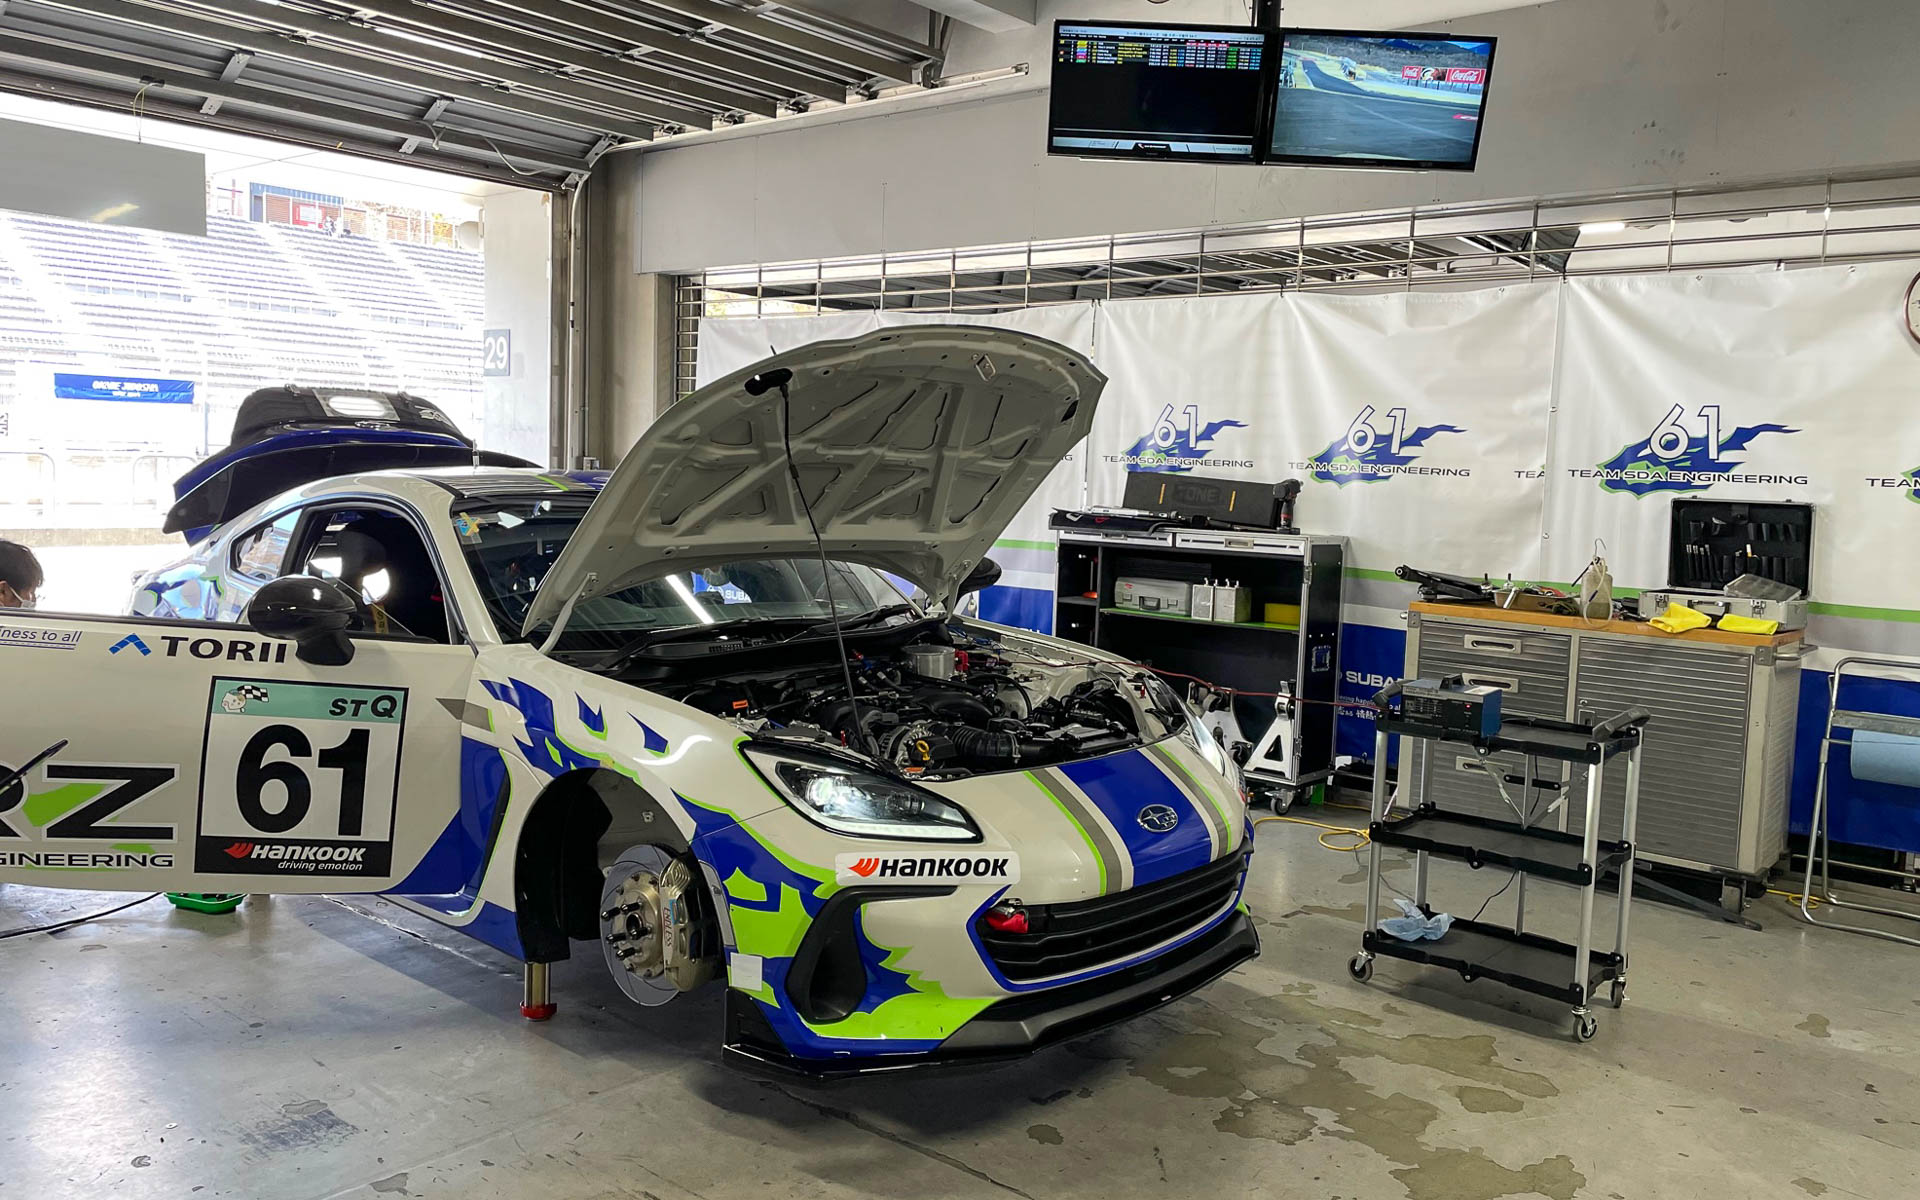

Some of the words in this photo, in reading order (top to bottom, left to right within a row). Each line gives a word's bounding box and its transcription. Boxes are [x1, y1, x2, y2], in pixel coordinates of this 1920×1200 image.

[484, 336, 507, 370] 29
[1154, 403, 1198, 449] 61
[1347, 404, 1406, 455] 61
[1650, 403, 1720, 460] 61
[1103, 455, 1136, 464] TEAM
[1166, 458, 1254, 468] ENGINEERING
[1288, 462, 1327, 471] TEAM
[1330, 463, 1358, 472] SDA
[1360, 465, 1470, 477] ENGINEERING
[1514, 470, 1545, 479] TEA
[1568, 469, 1619, 479] TEAM
[1624, 471, 1664, 481] SDA
[1669, 472, 1808, 485] ENGINEERING
[725, 589, 752, 602] SUBA
[0, 628, 38, 640] ness
[41, 630, 58, 642] to
[61, 631, 83, 643] all
[161, 636, 287, 664] TORII
[1346, 671, 1403, 688] SUBA
[236, 724, 370, 836] 61
[278, 861, 316, 871] driving
[318, 862, 363, 871] emotion
